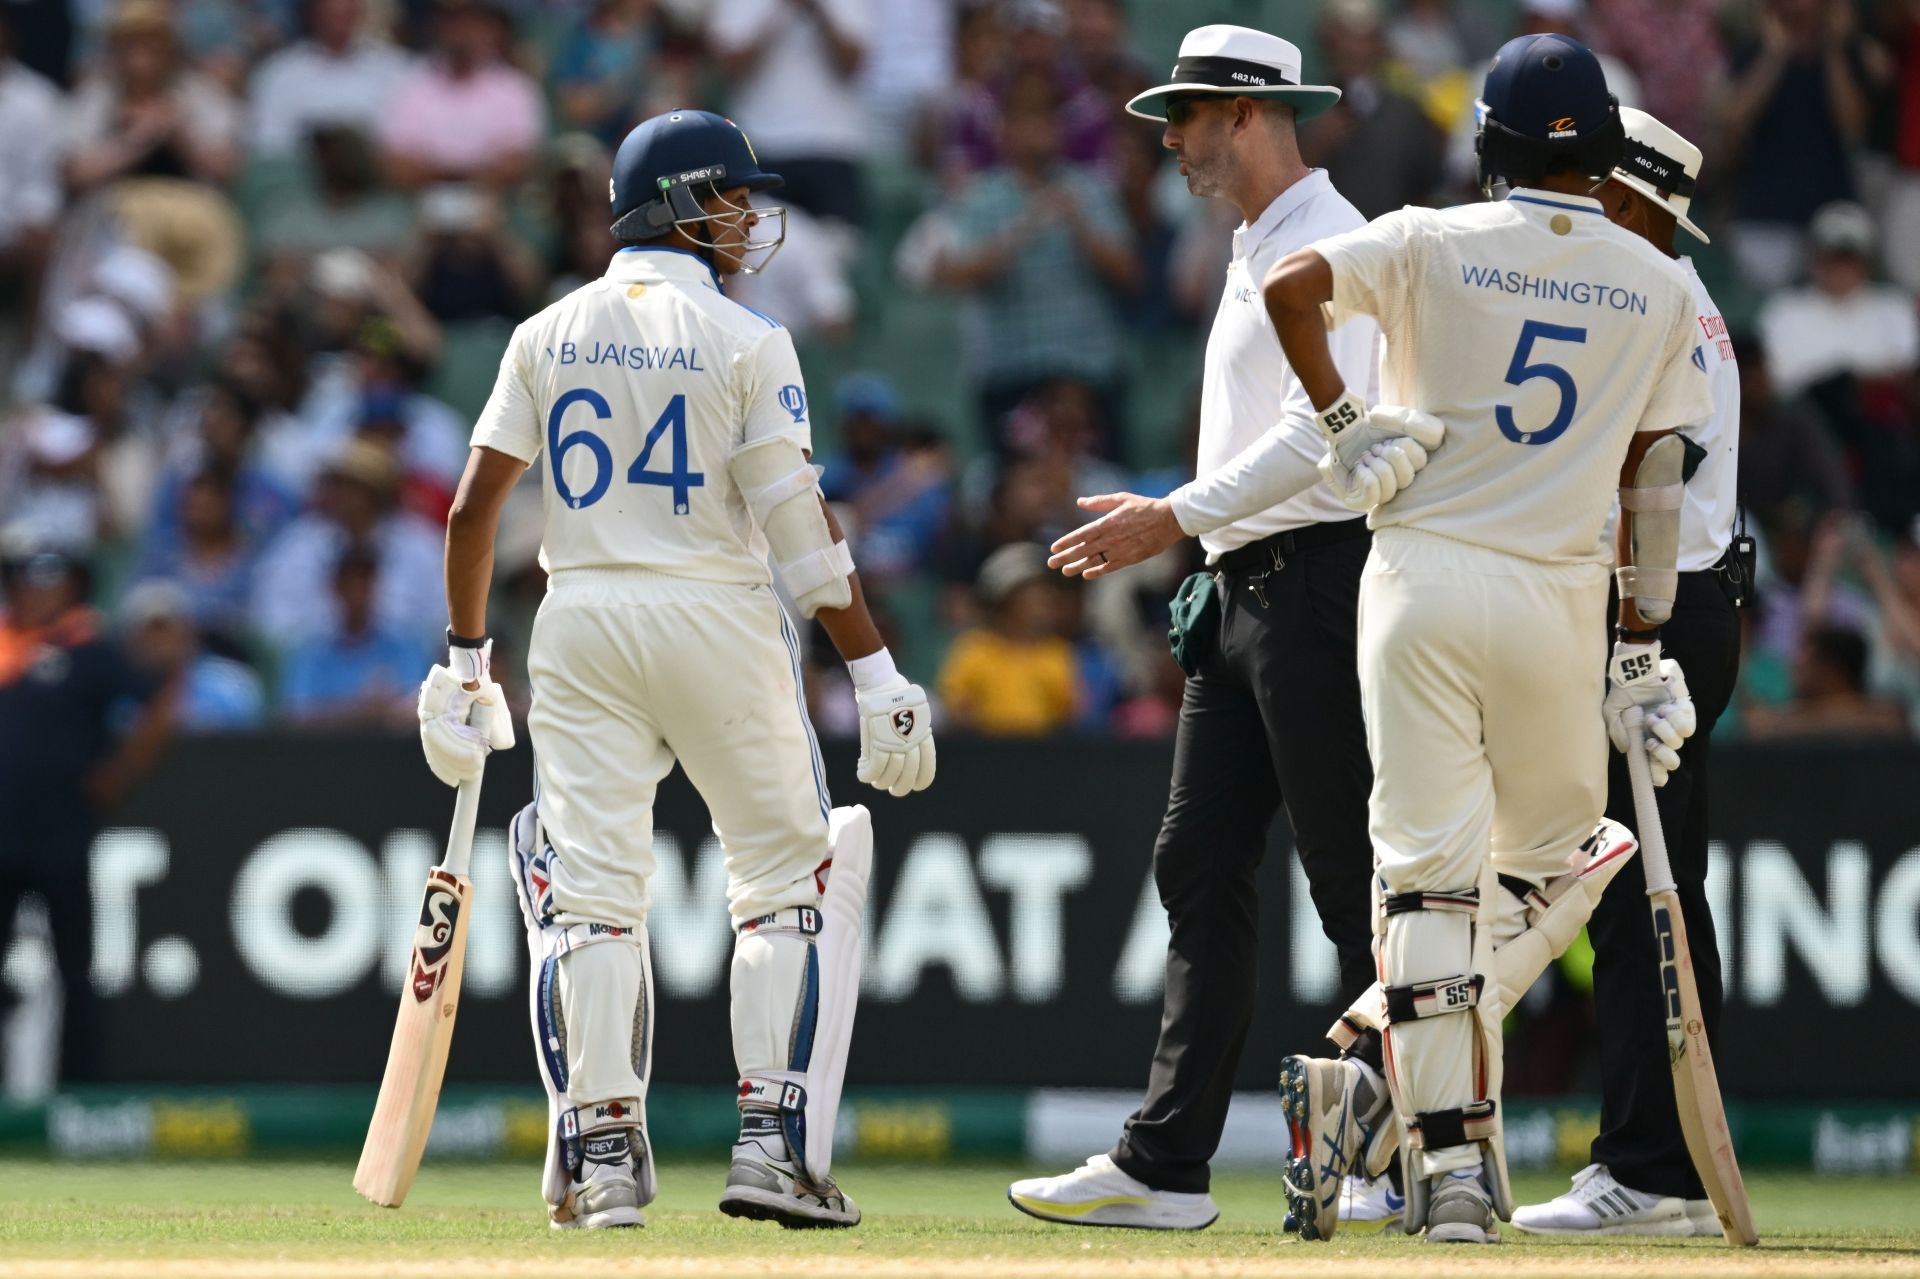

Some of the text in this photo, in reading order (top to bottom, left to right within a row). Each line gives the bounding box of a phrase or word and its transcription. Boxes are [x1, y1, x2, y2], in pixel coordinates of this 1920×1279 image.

[1231, 72, 1266, 86] 482 MG
[1548, 129, 1578, 139] FORMA
[680, 168, 711, 183] SHREY
[1634, 156, 1669, 178] 480 JW
[1461, 264, 1648, 316] WASHINGTON
[586, 341, 705, 372] JAISWAL
[1495, 319, 1588, 446] 5
[1323, 401, 1358, 434] SS
[547, 387, 705, 516] 64
[1620, 653, 1653, 681] SS
[1446, 983, 1469, 1006] SS
